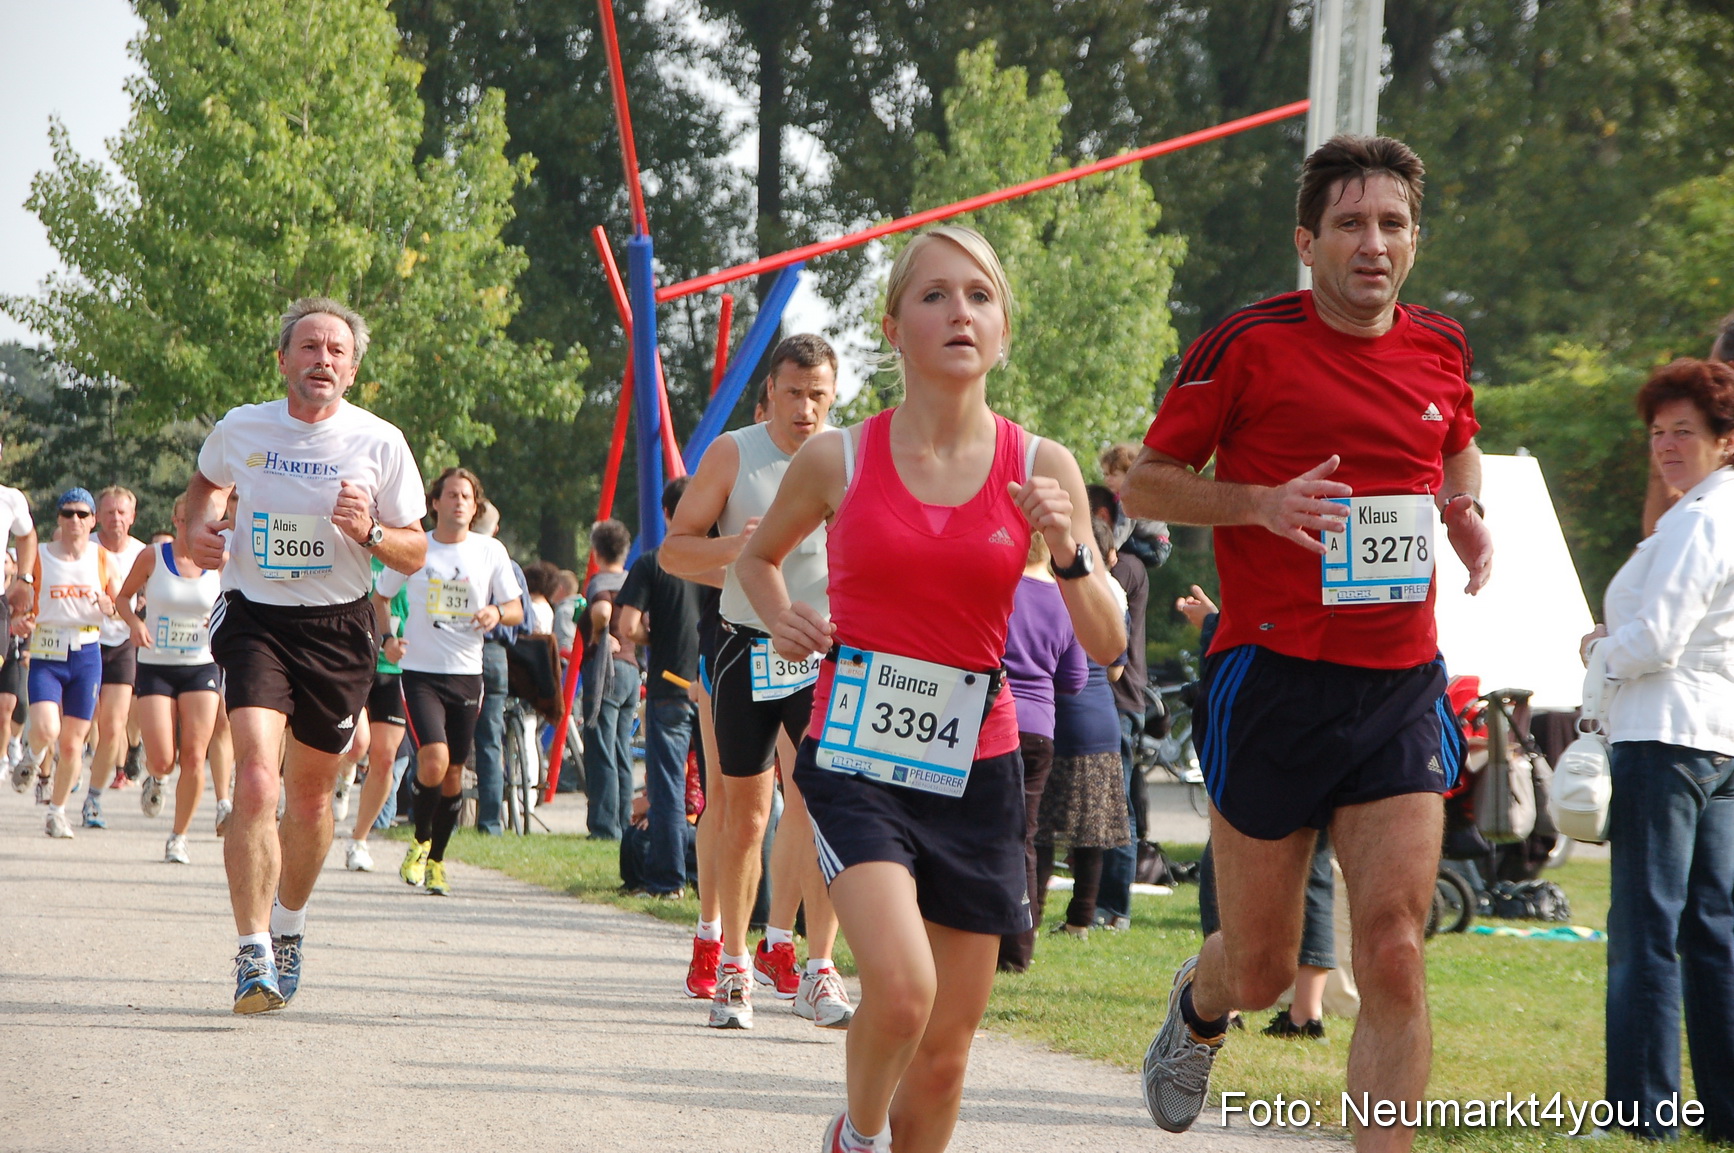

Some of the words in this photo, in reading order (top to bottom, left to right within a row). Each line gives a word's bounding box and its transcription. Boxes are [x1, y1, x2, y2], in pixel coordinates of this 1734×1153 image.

[264, 451, 338, 476] HÄRTEIS
[1359, 506, 1397, 524] Klaus
[273, 519, 297, 532] Alois
[256, 536, 261, 546] C
[273, 539, 325, 557] 3606
[989, 536, 1015, 547] adidas
[1331, 537, 1338, 551] A
[1362, 535, 1428, 564] 3278
[50, 584, 92, 599] DAK
[446, 596, 469, 609] 331
[41, 636, 60, 648] 301
[171, 630, 199, 642] 2770
[756, 661, 761, 670] B
[775, 658, 819, 676] 3684
[878, 664, 938, 697] Bianca
[839, 693, 847, 709] A
[871, 702, 960, 749] 3394
[832, 756, 873, 771] BOCK
[909, 768, 964, 789] PFLEIDERER
